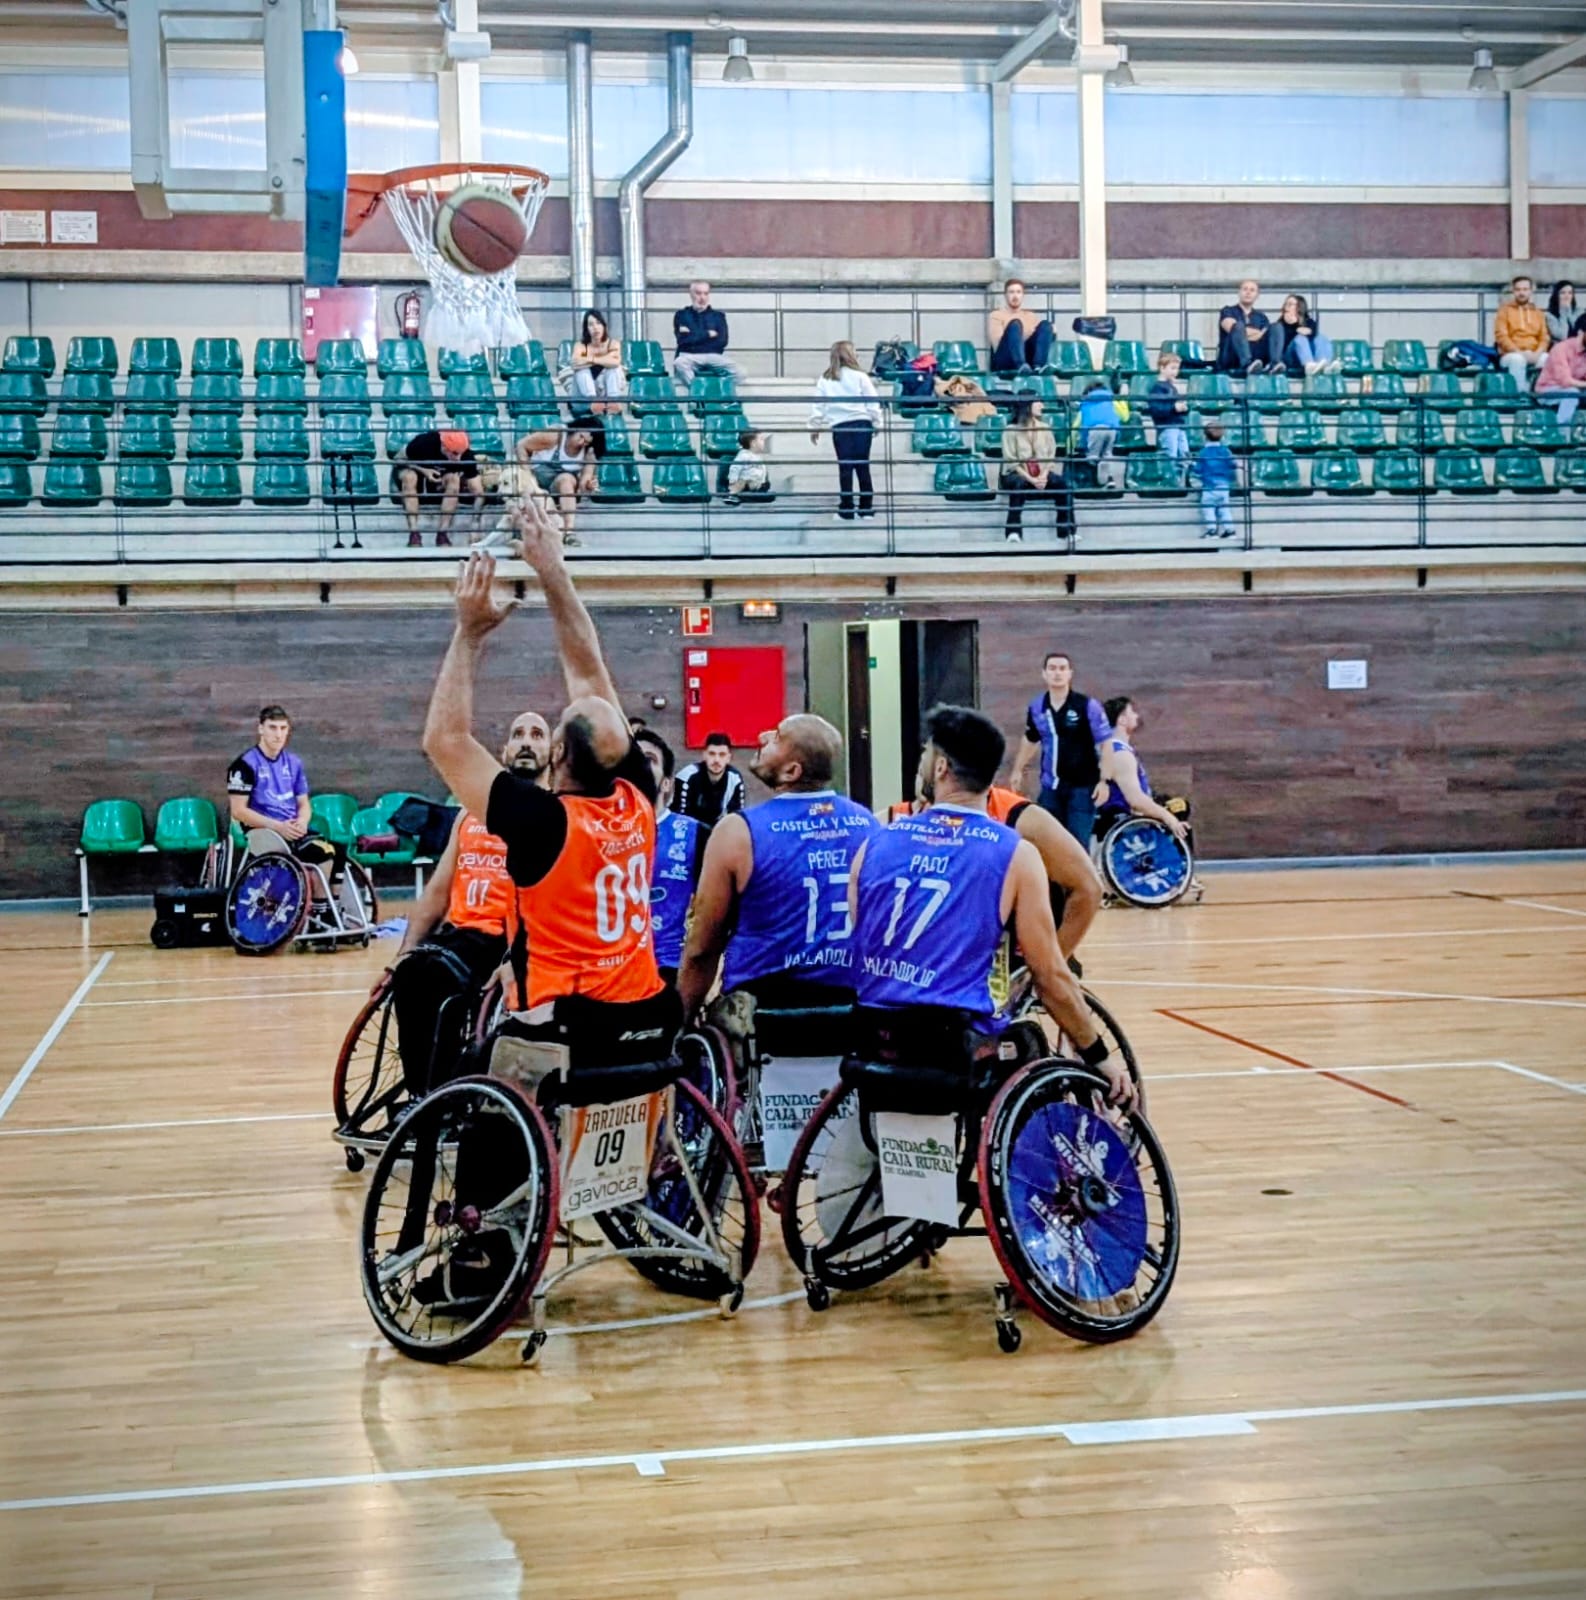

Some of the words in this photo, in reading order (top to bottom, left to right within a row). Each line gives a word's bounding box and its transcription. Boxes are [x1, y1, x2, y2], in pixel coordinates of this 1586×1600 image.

[771, 818, 827, 832] CASTILLA
[831, 817, 839, 830] Y
[843, 815, 870, 826] LEÓN
[887, 821, 945, 835] CASTILLA
[952, 826, 961, 838] Y
[964, 826, 1000, 843] LEÓN
[807, 848, 848, 870] PÉREZ
[803, 873, 853, 943] 13
[883, 877, 951, 950] 17
[585, 1102, 648, 1133] ZARZUELA
[765, 1107, 798, 1121] CAJA
[594, 1129, 625, 1168] 09
[882, 1151, 912, 1168] CAJA
[915, 1155, 955, 1175] RURAL
